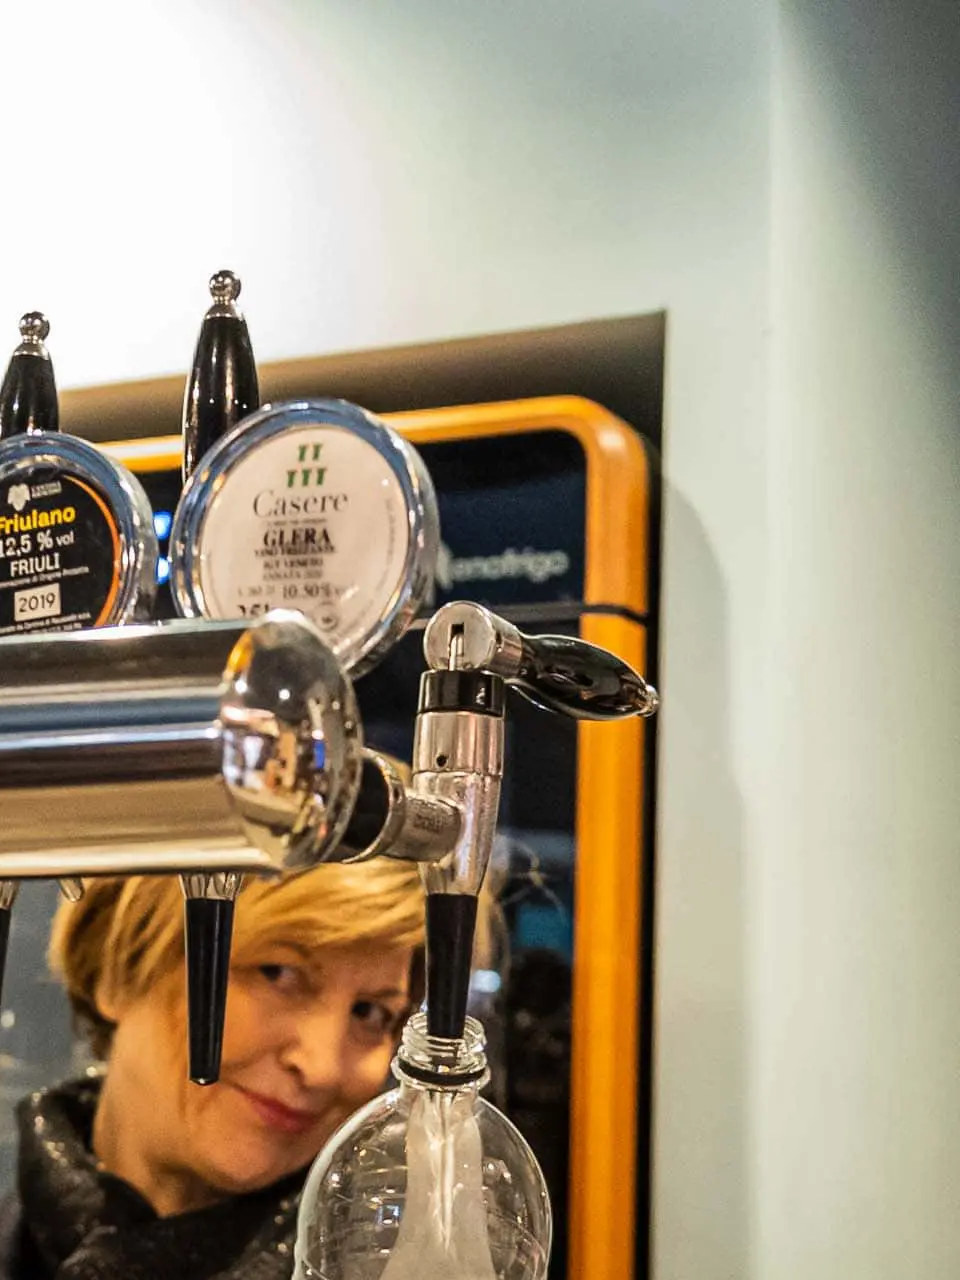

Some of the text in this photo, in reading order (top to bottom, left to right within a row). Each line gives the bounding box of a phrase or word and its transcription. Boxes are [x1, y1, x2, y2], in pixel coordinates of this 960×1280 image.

[253, 488, 348, 519] Casere
[37, 530, 53, 551] %
[56, 531, 74, 547] vol
[263, 528, 331, 547] GLERA
[10, 553, 60, 577] FRIULI
[18, 592, 57, 613] 2019
